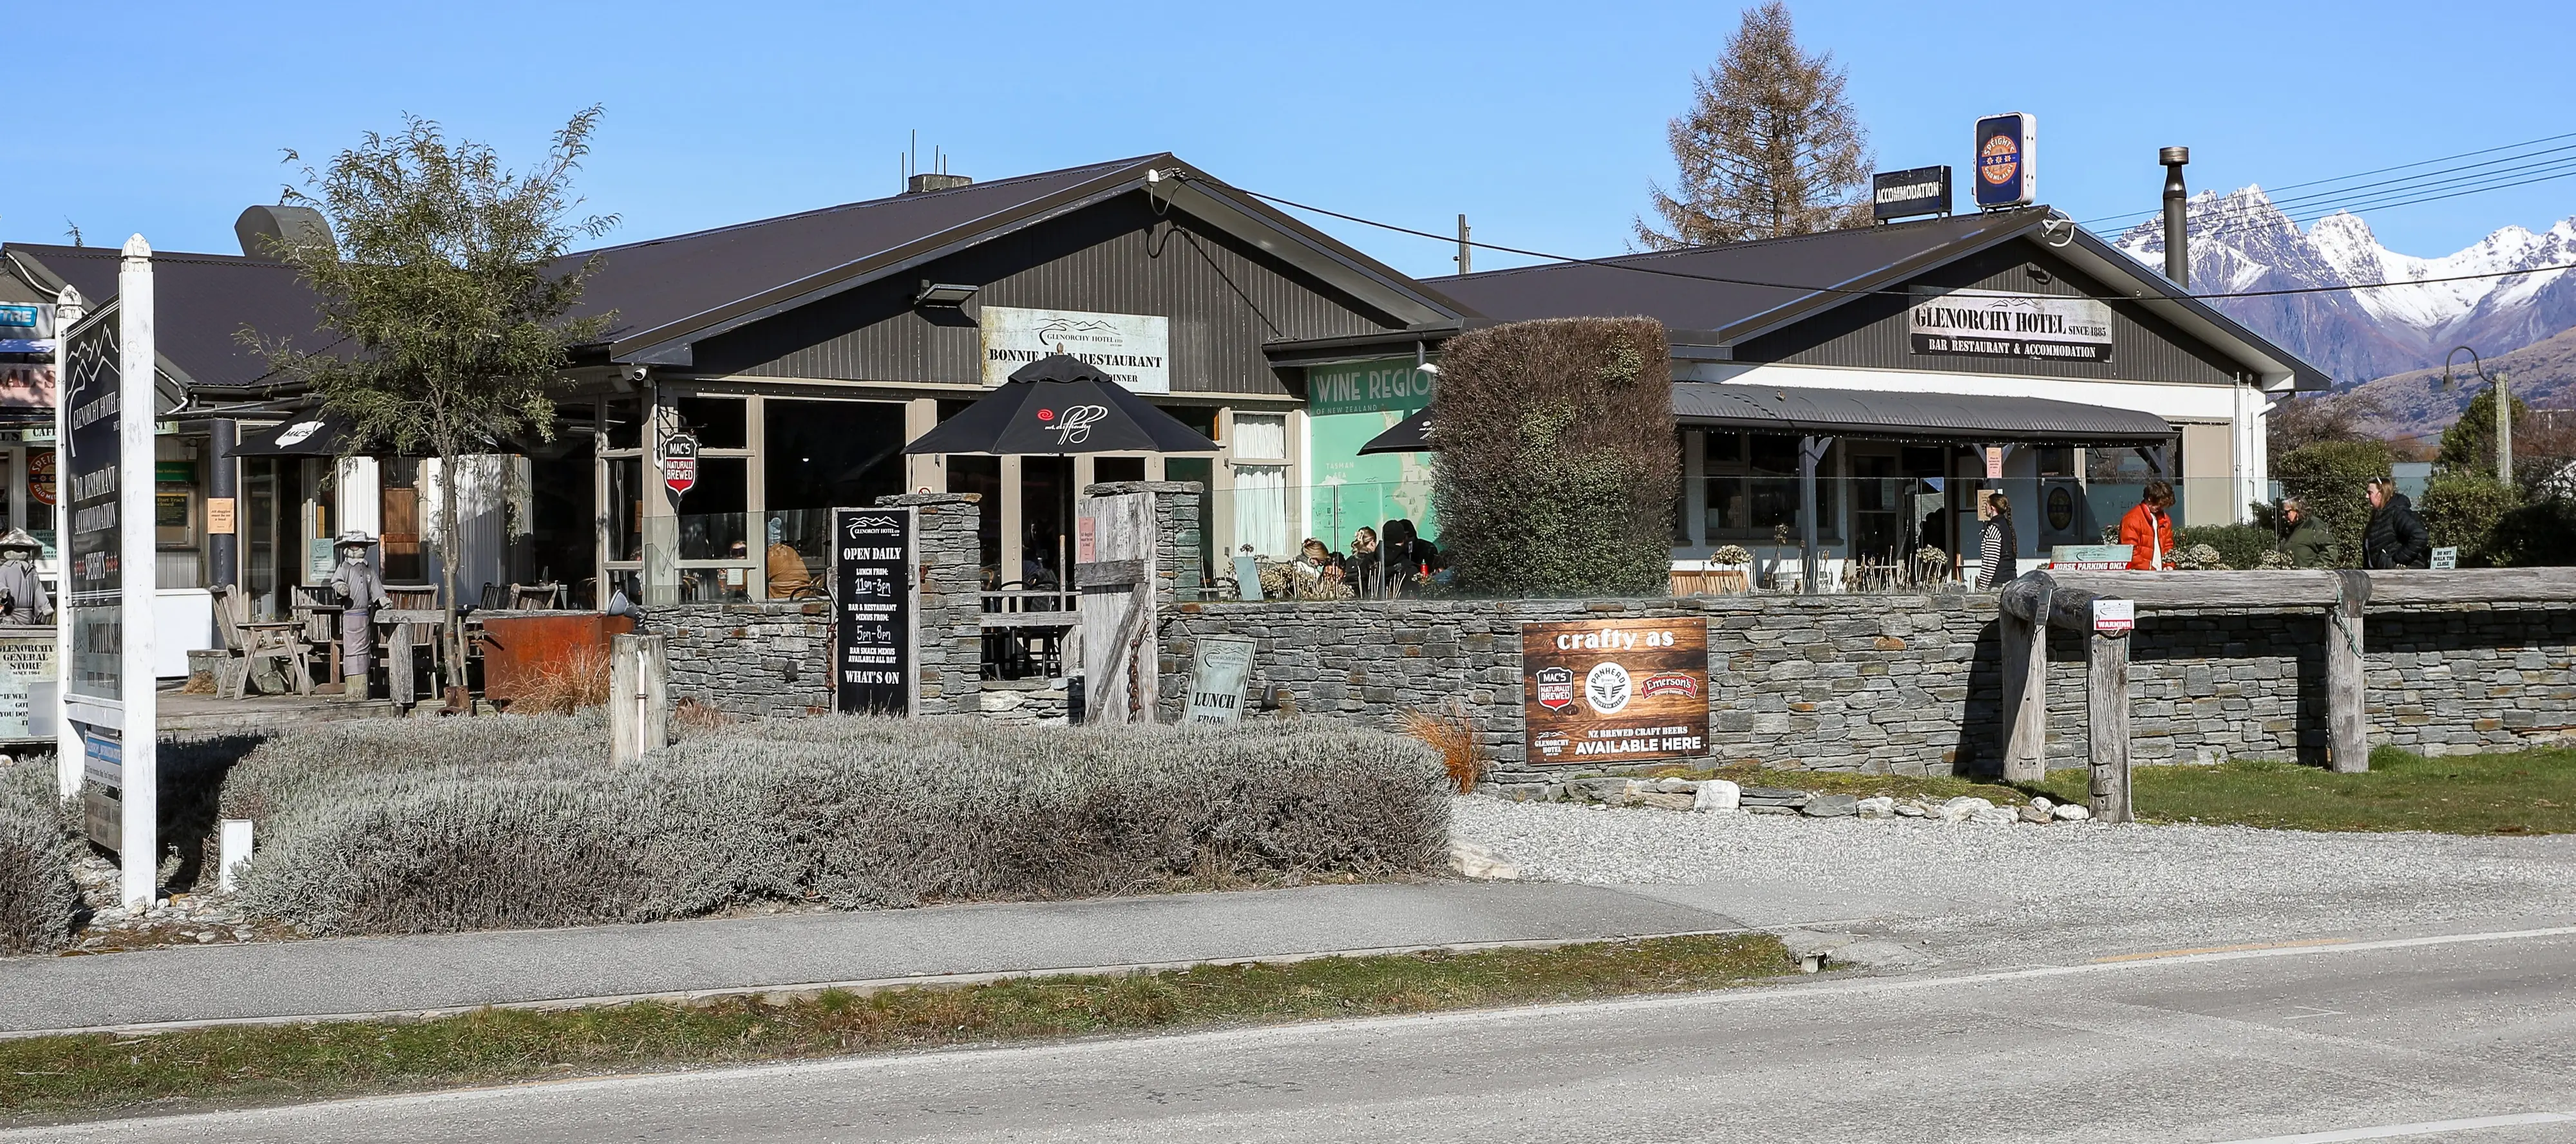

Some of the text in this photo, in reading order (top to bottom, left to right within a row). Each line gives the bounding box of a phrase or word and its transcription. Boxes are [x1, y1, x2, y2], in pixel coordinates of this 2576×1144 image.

[1875, 181, 1940, 204] ACCOMMODATION
[0, 310, 32, 323] TRE
[1915, 307, 2107, 337] GLENORCHY HOTEL SINCE 1885
[1929, 339, 2096, 358] BAR RESTAURANT & ACCOMMODATION
[989, 348, 1039, 363] BONNIE
[1079, 353, 1162, 368] RESTAURANT
[1314, 372, 1361, 403] WINE
[73, 399, 99, 431] GLENORCHY
[100, 391, 117, 419] HOTEL
[1345, 404, 1378, 413] ZEALAND
[670, 443, 691, 455] MAC'S
[667, 460, 694, 469] NATURALLY
[1326, 462, 1354, 471] TASMAN
[667, 469, 694, 480] BREWED
[74, 465, 115, 502] BAR RESTAURANT
[75, 501, 116, 535] ACCOMMODATION
[844, 547, 902, 560] OPEN DAILY
[1557, 628, 1674, 650] crafty as
[3, 653, 48, 661] GENERAL
[10, 662, 42, 670] STORE
[845, 670, 900, 684] WHAT'S ON
[1544, 673, 1566, 682] MAC'S
[1591, 668, 1625, 684] PANHEAD
[1646, 678, 1692, 691] Emerson's
[1194, 691, 1236, 709] LUNCH
[1540, 691, 1570, 700] BREWED
[1588, 726, 1688, 738] NZ BREWED CRAFT BEERS
[1534, 739, 1569, 747] GLENORCHY
[1575, 736, 1701, 755] AVAILABLE HERE
